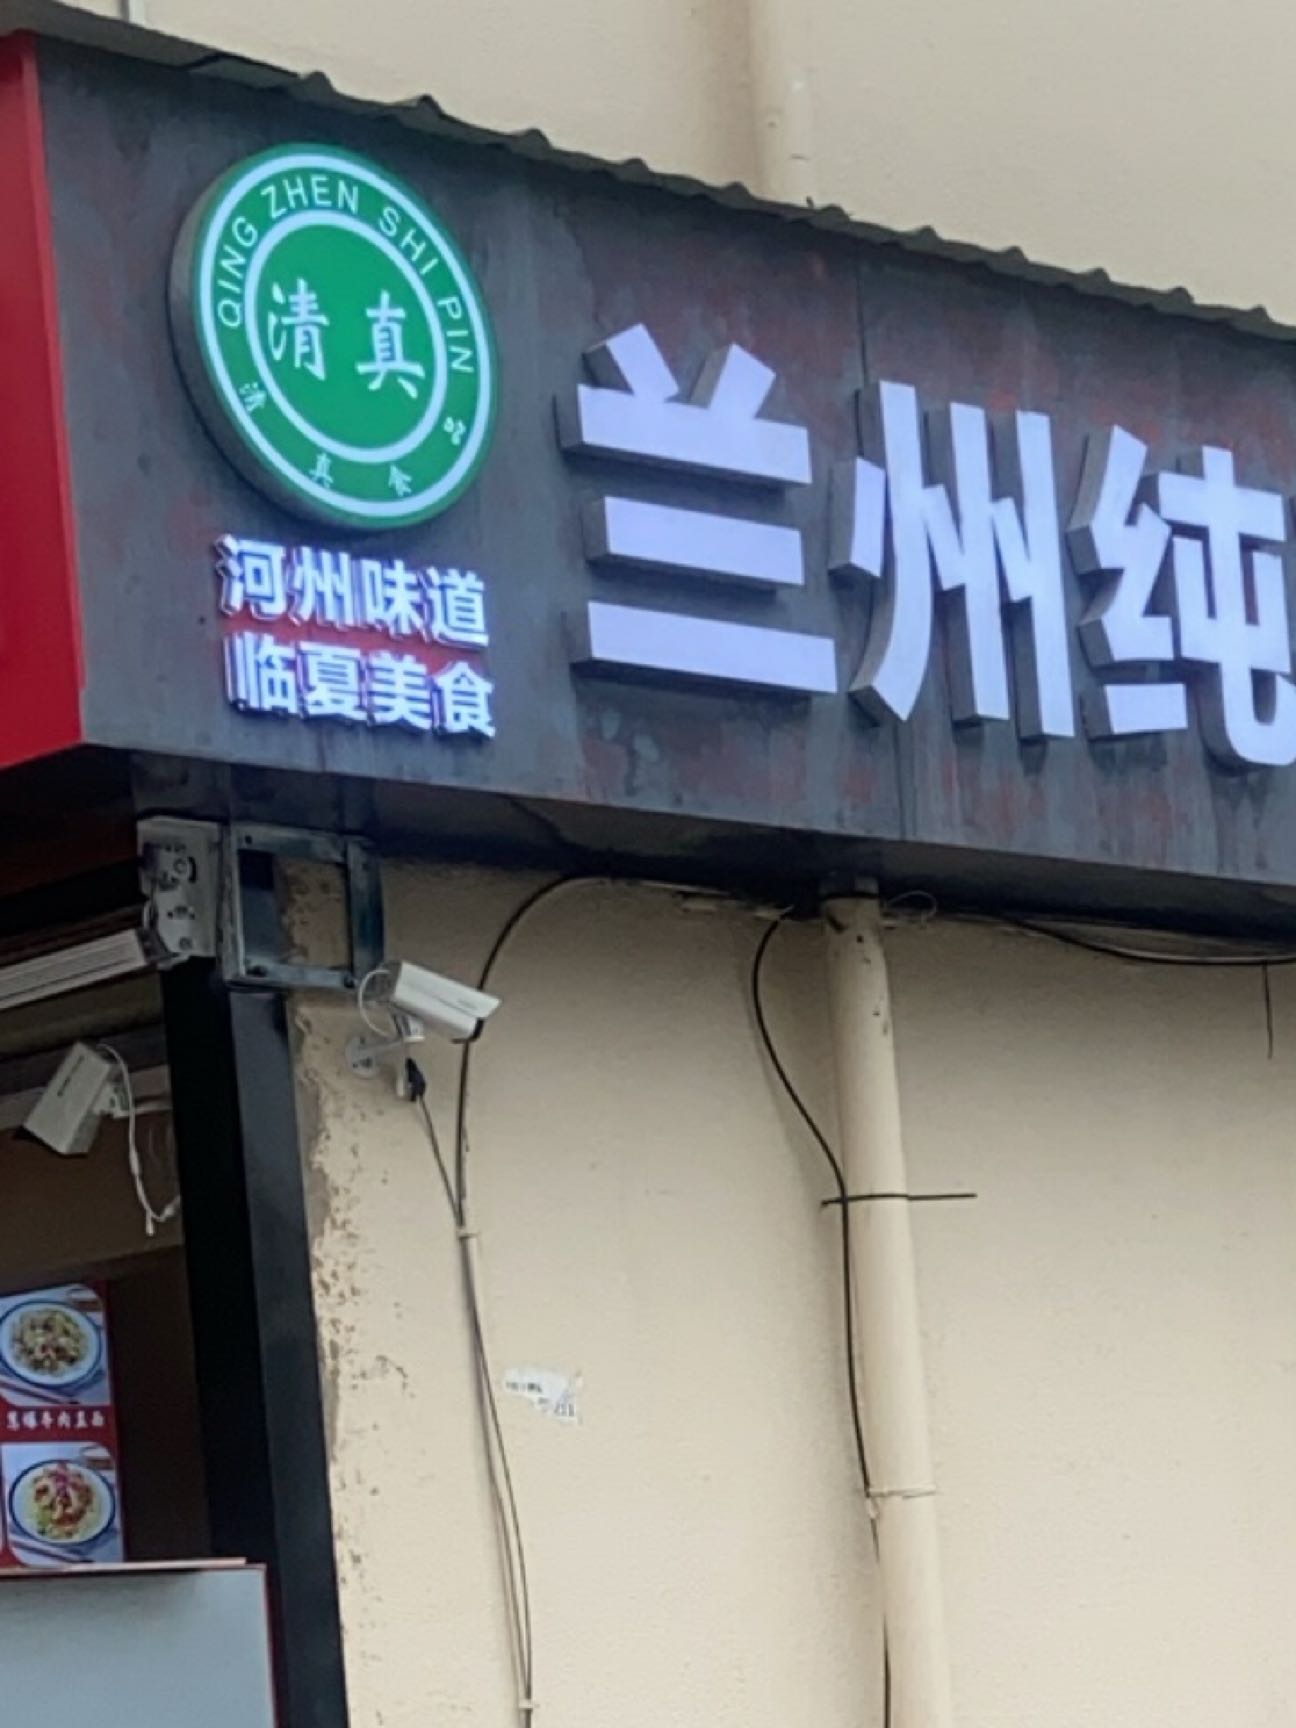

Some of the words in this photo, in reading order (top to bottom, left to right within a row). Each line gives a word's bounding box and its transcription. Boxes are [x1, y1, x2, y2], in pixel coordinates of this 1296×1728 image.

[217, 216, 258, 328] QING
[261, 174, 360, 219] ZHEN
[379, 207, 440, 275] SHI
[437, 296, 475, 374] PIN
[267, 278, 426, 399] 清真
[216, 534, 489, 647] 河州味道
[227, 631, 496, 738] 临夏美食
